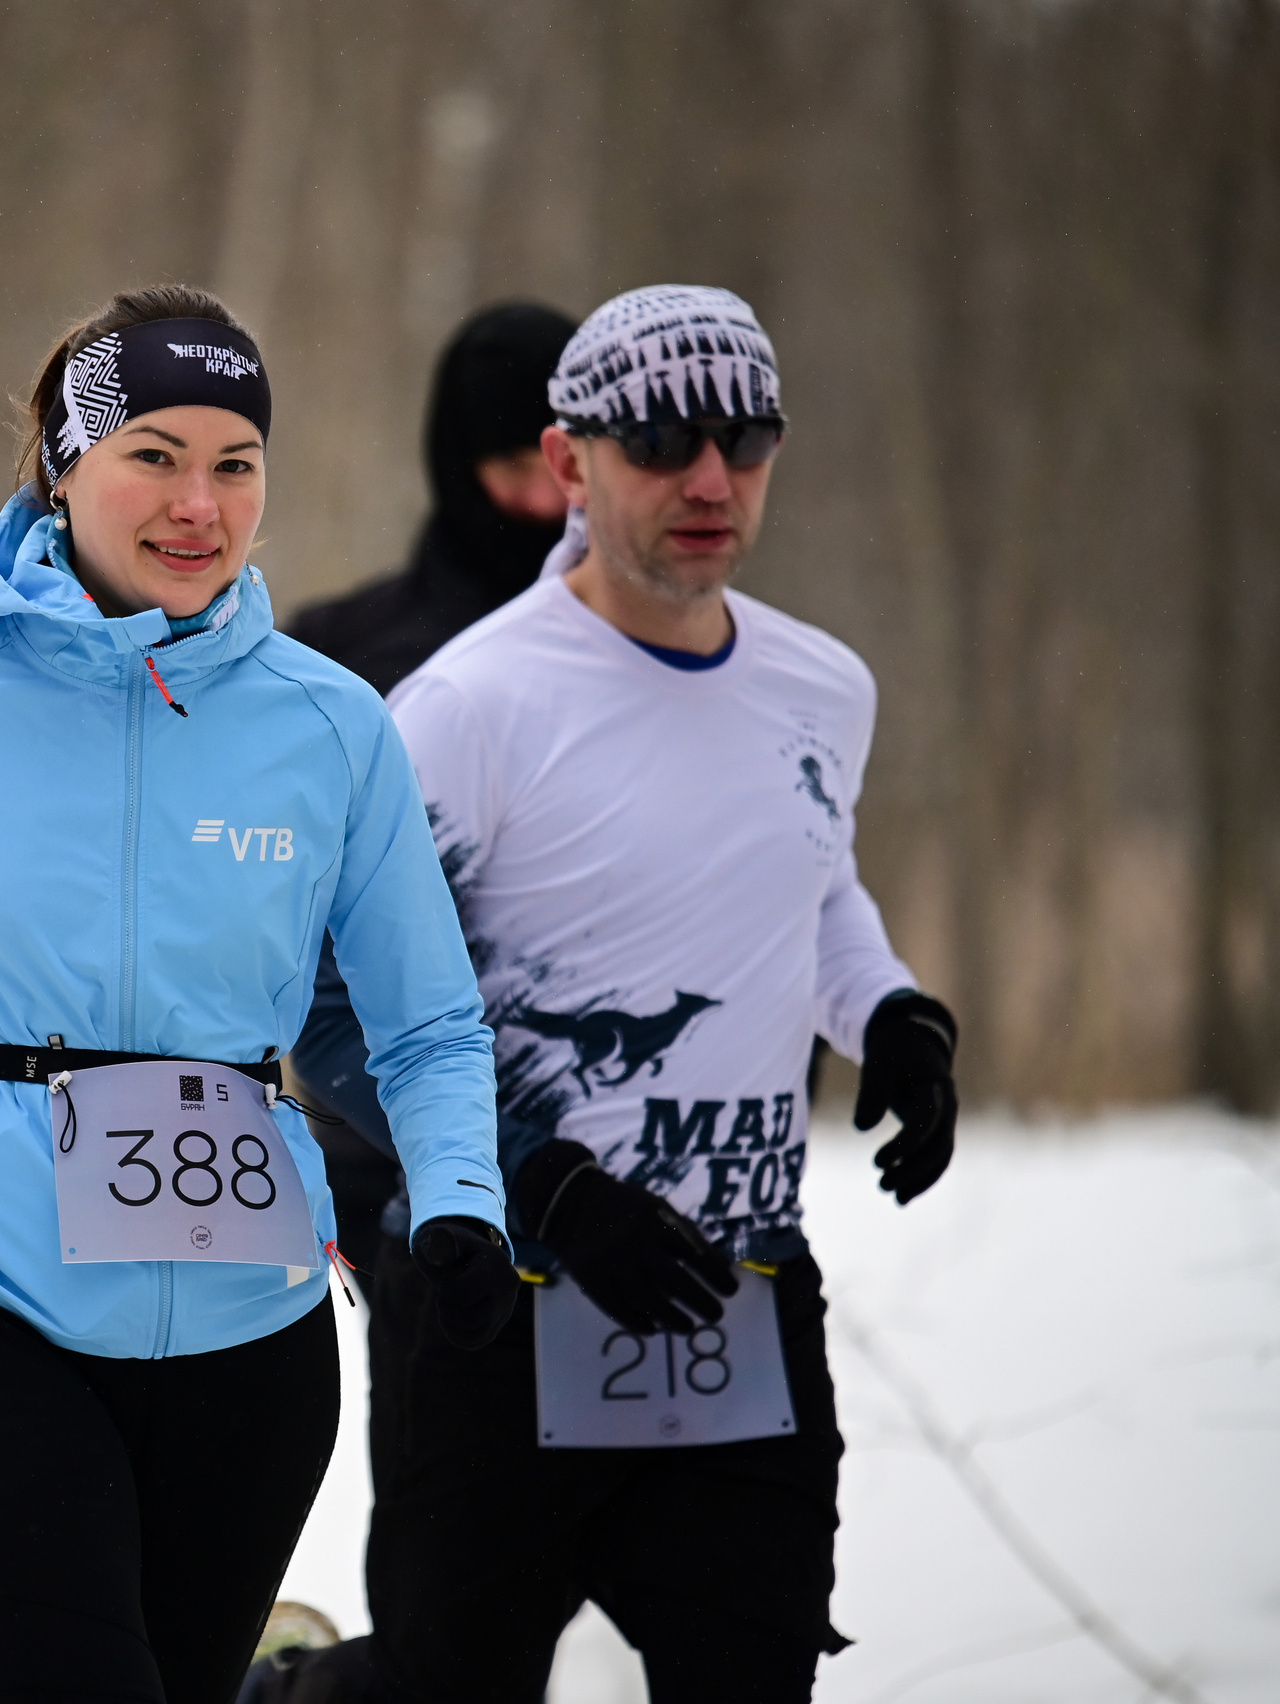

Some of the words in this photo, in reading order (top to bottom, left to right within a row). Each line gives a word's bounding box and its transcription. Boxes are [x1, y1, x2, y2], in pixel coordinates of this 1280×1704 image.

[228, 828, 294, 862] VTB
[25, 1056, 37, 1078] MSE
[216, 1083, 229, 1102] 5
[634, 1091, 794, 1154] MAD
[105, 1129, 277, 1211] 388
[600, 1324, 732, 1400] 218
